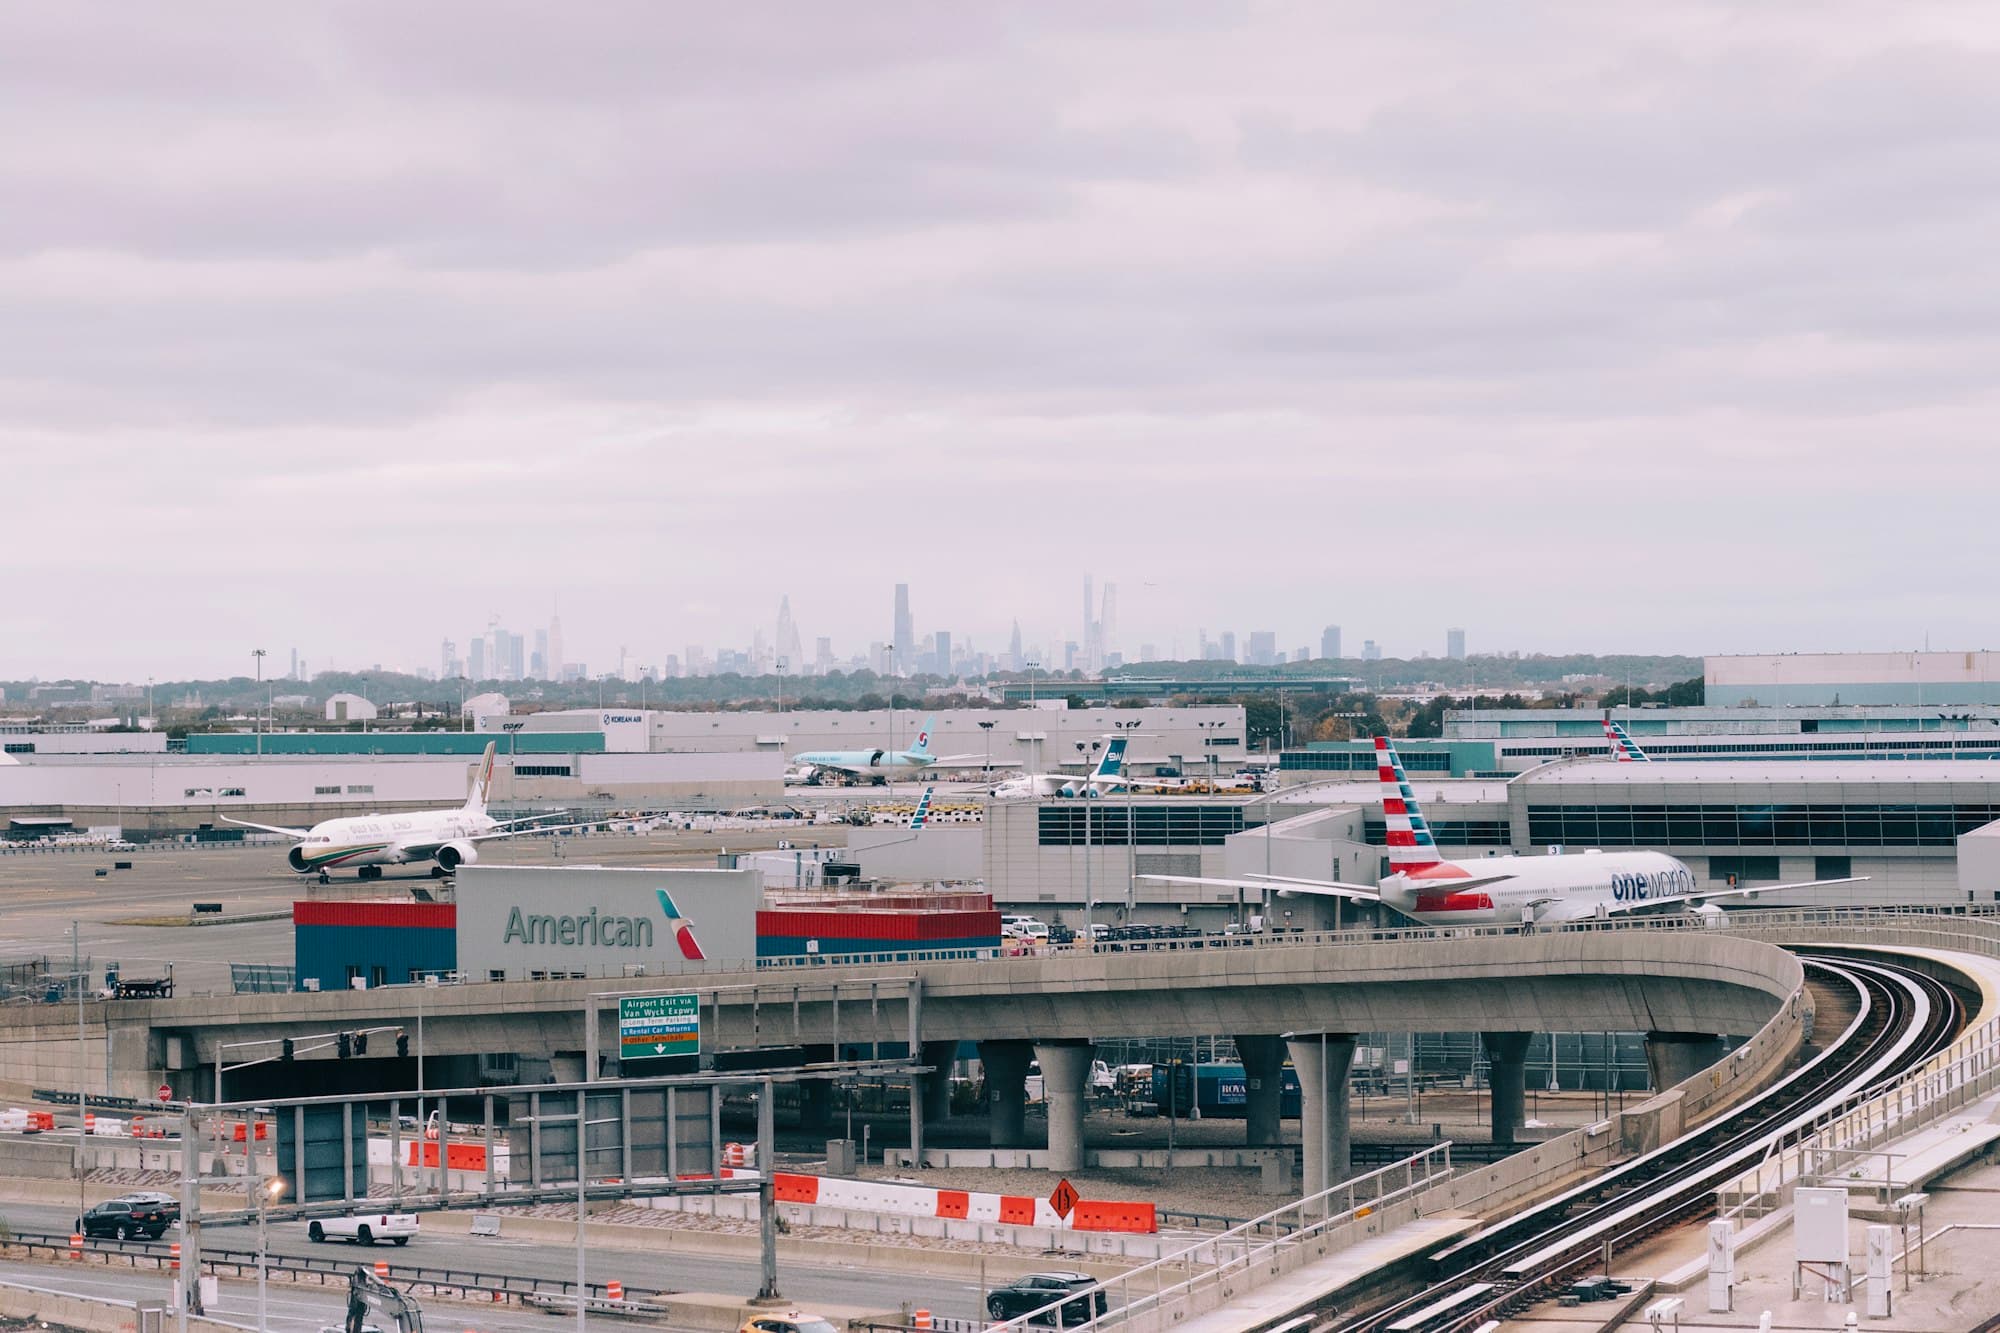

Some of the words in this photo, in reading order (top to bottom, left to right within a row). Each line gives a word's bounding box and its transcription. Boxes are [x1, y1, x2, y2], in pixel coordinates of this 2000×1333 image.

[611, 715, 632, 723] KOREAN
[633, 715, 642, 723] AIR
[1551, 846, 1558, 855] 3
[1612, 863, 1690, 901] oneworld
[503, 906, 653, 947] American
[627, 1000, 657, 1009] Airport
[660, 998, 676, 1006] Exit
[644, 1008, 665, 1017] Wyck
[668, 1007, 695, 1015] Expwy
[629, 1027, 650, 1035] Rental
[652, 1026, 663, 1034] Car
[665, 1025, 691, 1033] Returns
[1221, 1084, 1247, 1093] ROYA
